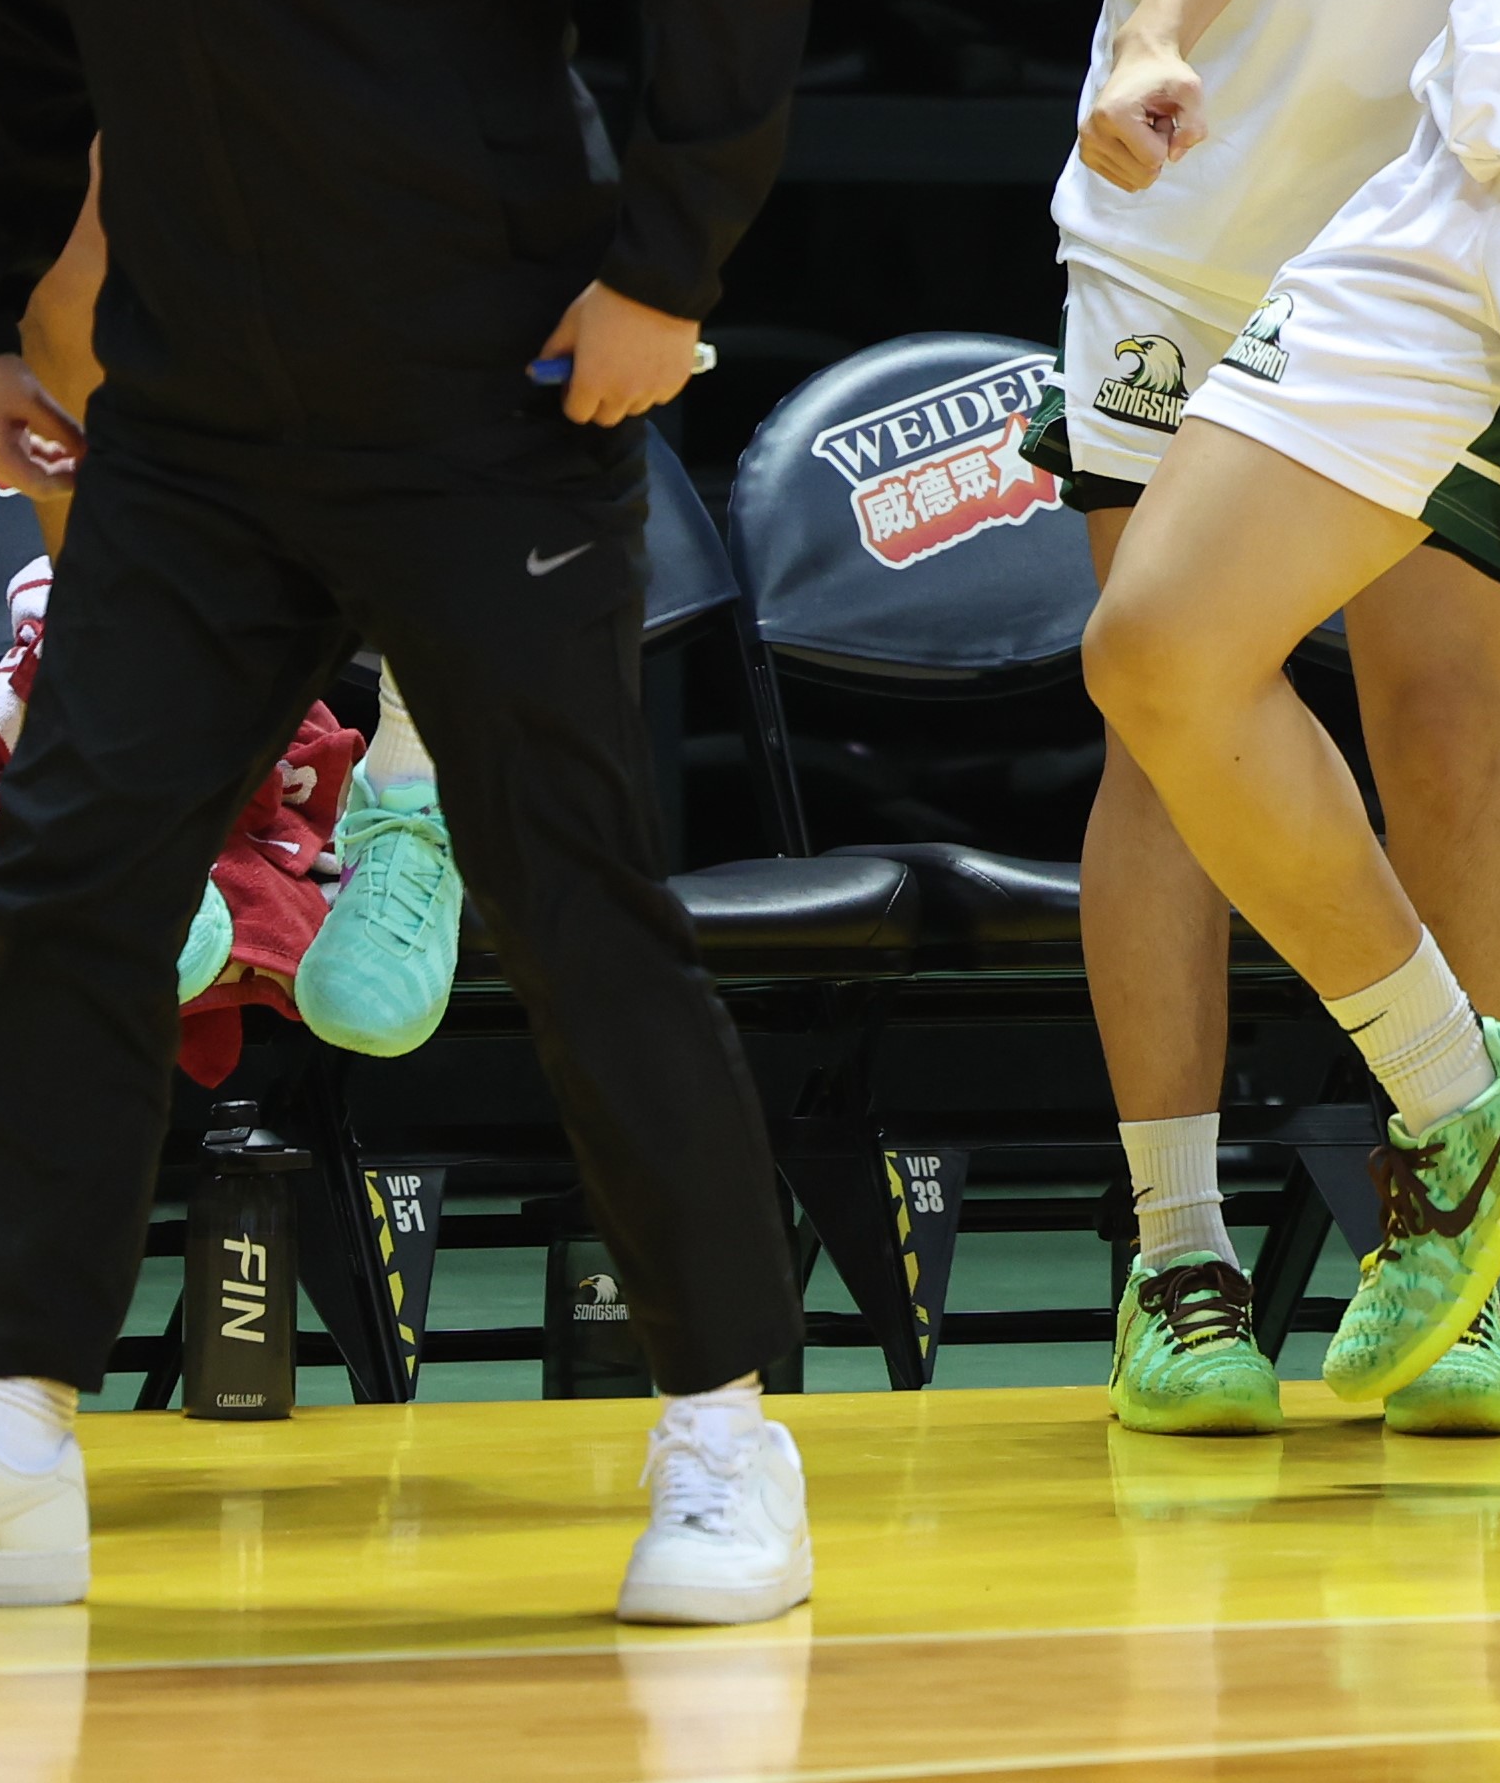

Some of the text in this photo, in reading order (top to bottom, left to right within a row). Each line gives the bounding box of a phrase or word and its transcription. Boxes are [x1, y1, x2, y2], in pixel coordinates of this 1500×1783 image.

[905, 1156, 941, 1177] VIP
[386, 1175, 422, 1196] VIP
[911, 1180, 945, 1213] 38
[392, 1199, 426, 1233] 51
[222, 1232, 267, 1344] FIN
[573, 1303, 630, 1321] SONGSHA
[216, 1393, 266, 1407] CAMELBAK
